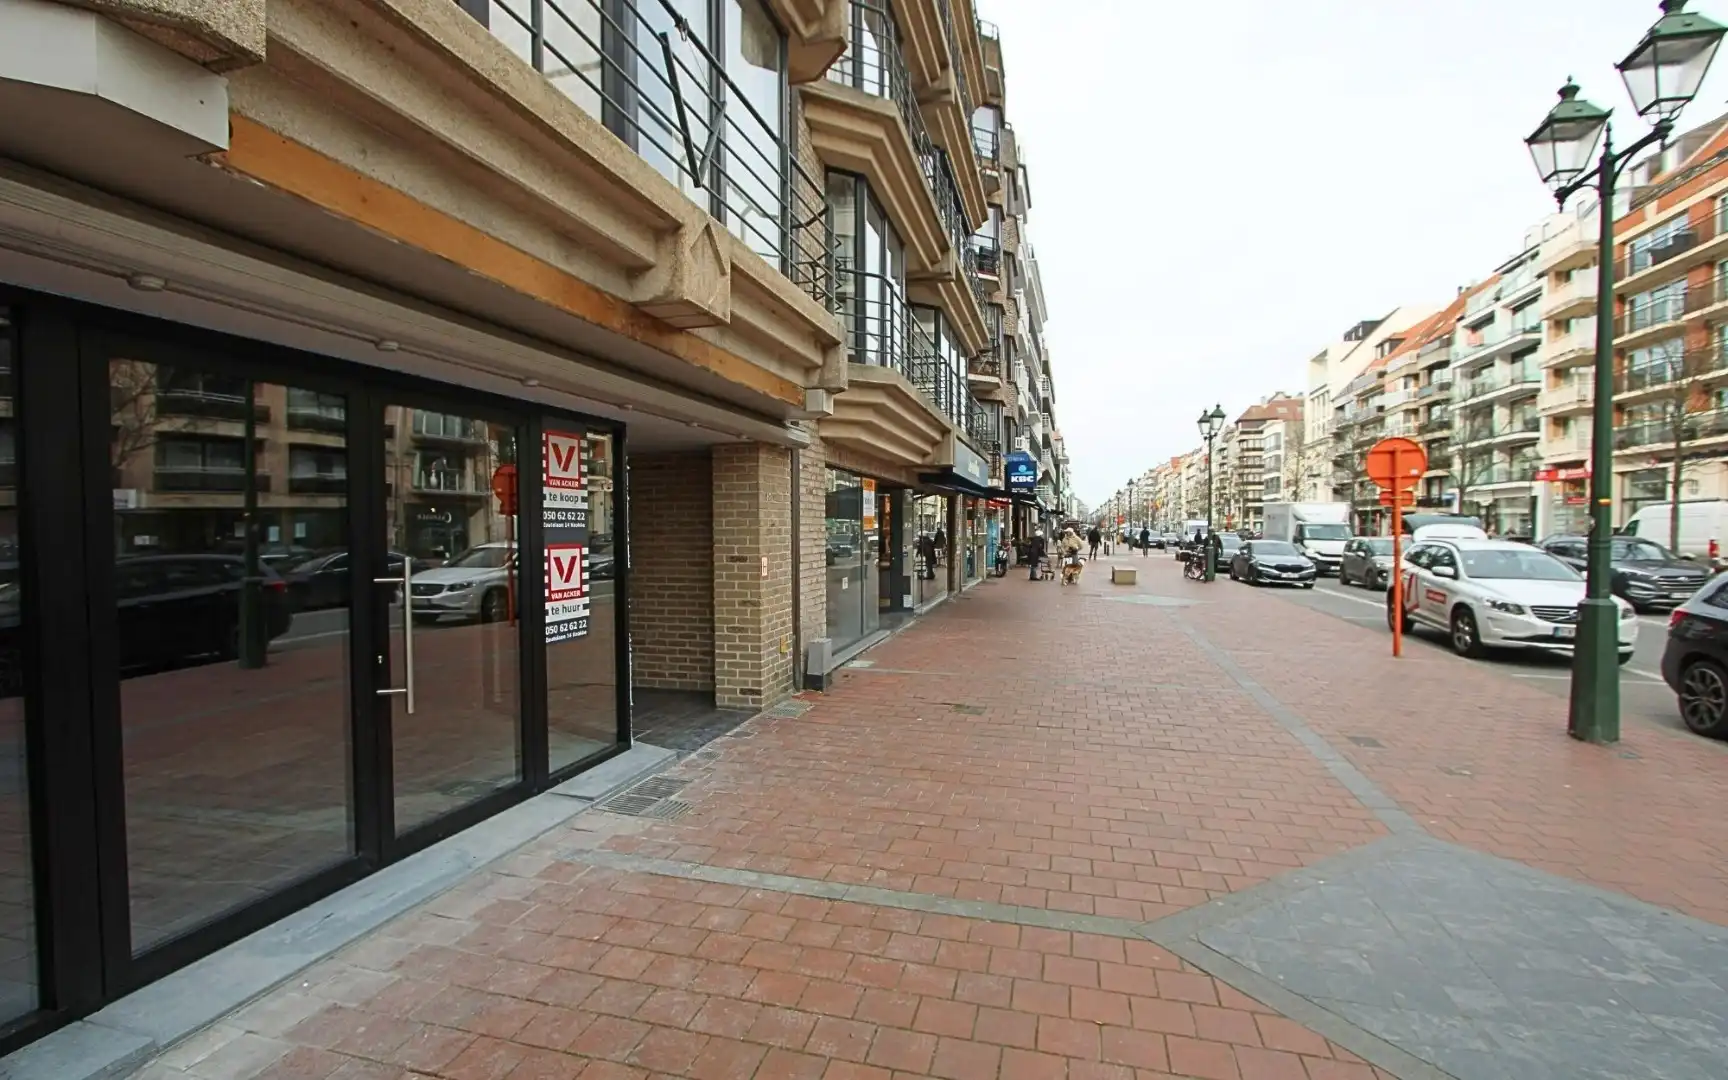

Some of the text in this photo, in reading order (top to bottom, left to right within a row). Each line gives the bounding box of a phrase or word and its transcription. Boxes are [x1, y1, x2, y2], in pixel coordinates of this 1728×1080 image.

[551, 443, 576, 472] V
[549, 492, 579, 504] te koop
[543, 511, 586, 520] 050 62 62 22
[553, 556, 577, 584] V
[563, 590, 580, 599] ACKER
[551, 604, 580, 615] te huur
[546, 620, 587, 636] 050 62 62 22
